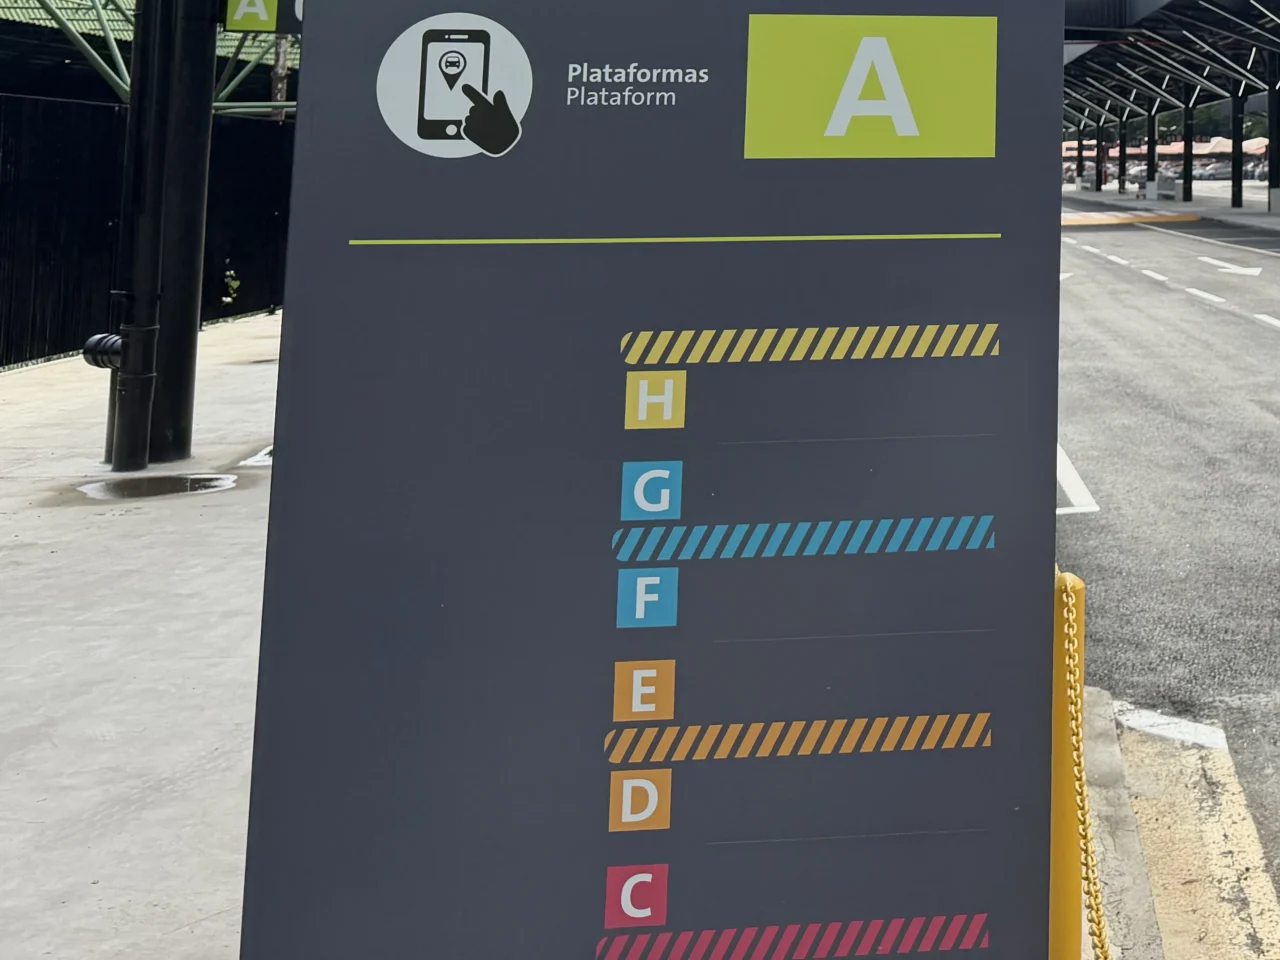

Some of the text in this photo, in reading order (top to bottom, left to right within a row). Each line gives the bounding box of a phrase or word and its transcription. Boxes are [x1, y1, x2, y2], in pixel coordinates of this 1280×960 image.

[567, 62, 710, 84] Plataformas
[824, 37, 920, 137] A
[566, 85, 677, 107] Plataform
[637, 379, 675, 421] H
[633, 469, 671, 513] G
[634, 576, 661, 619] F
[631, 669, 658, 713] E
[620, 778, 659, 824] D
[620, 873, 654, 919] C
